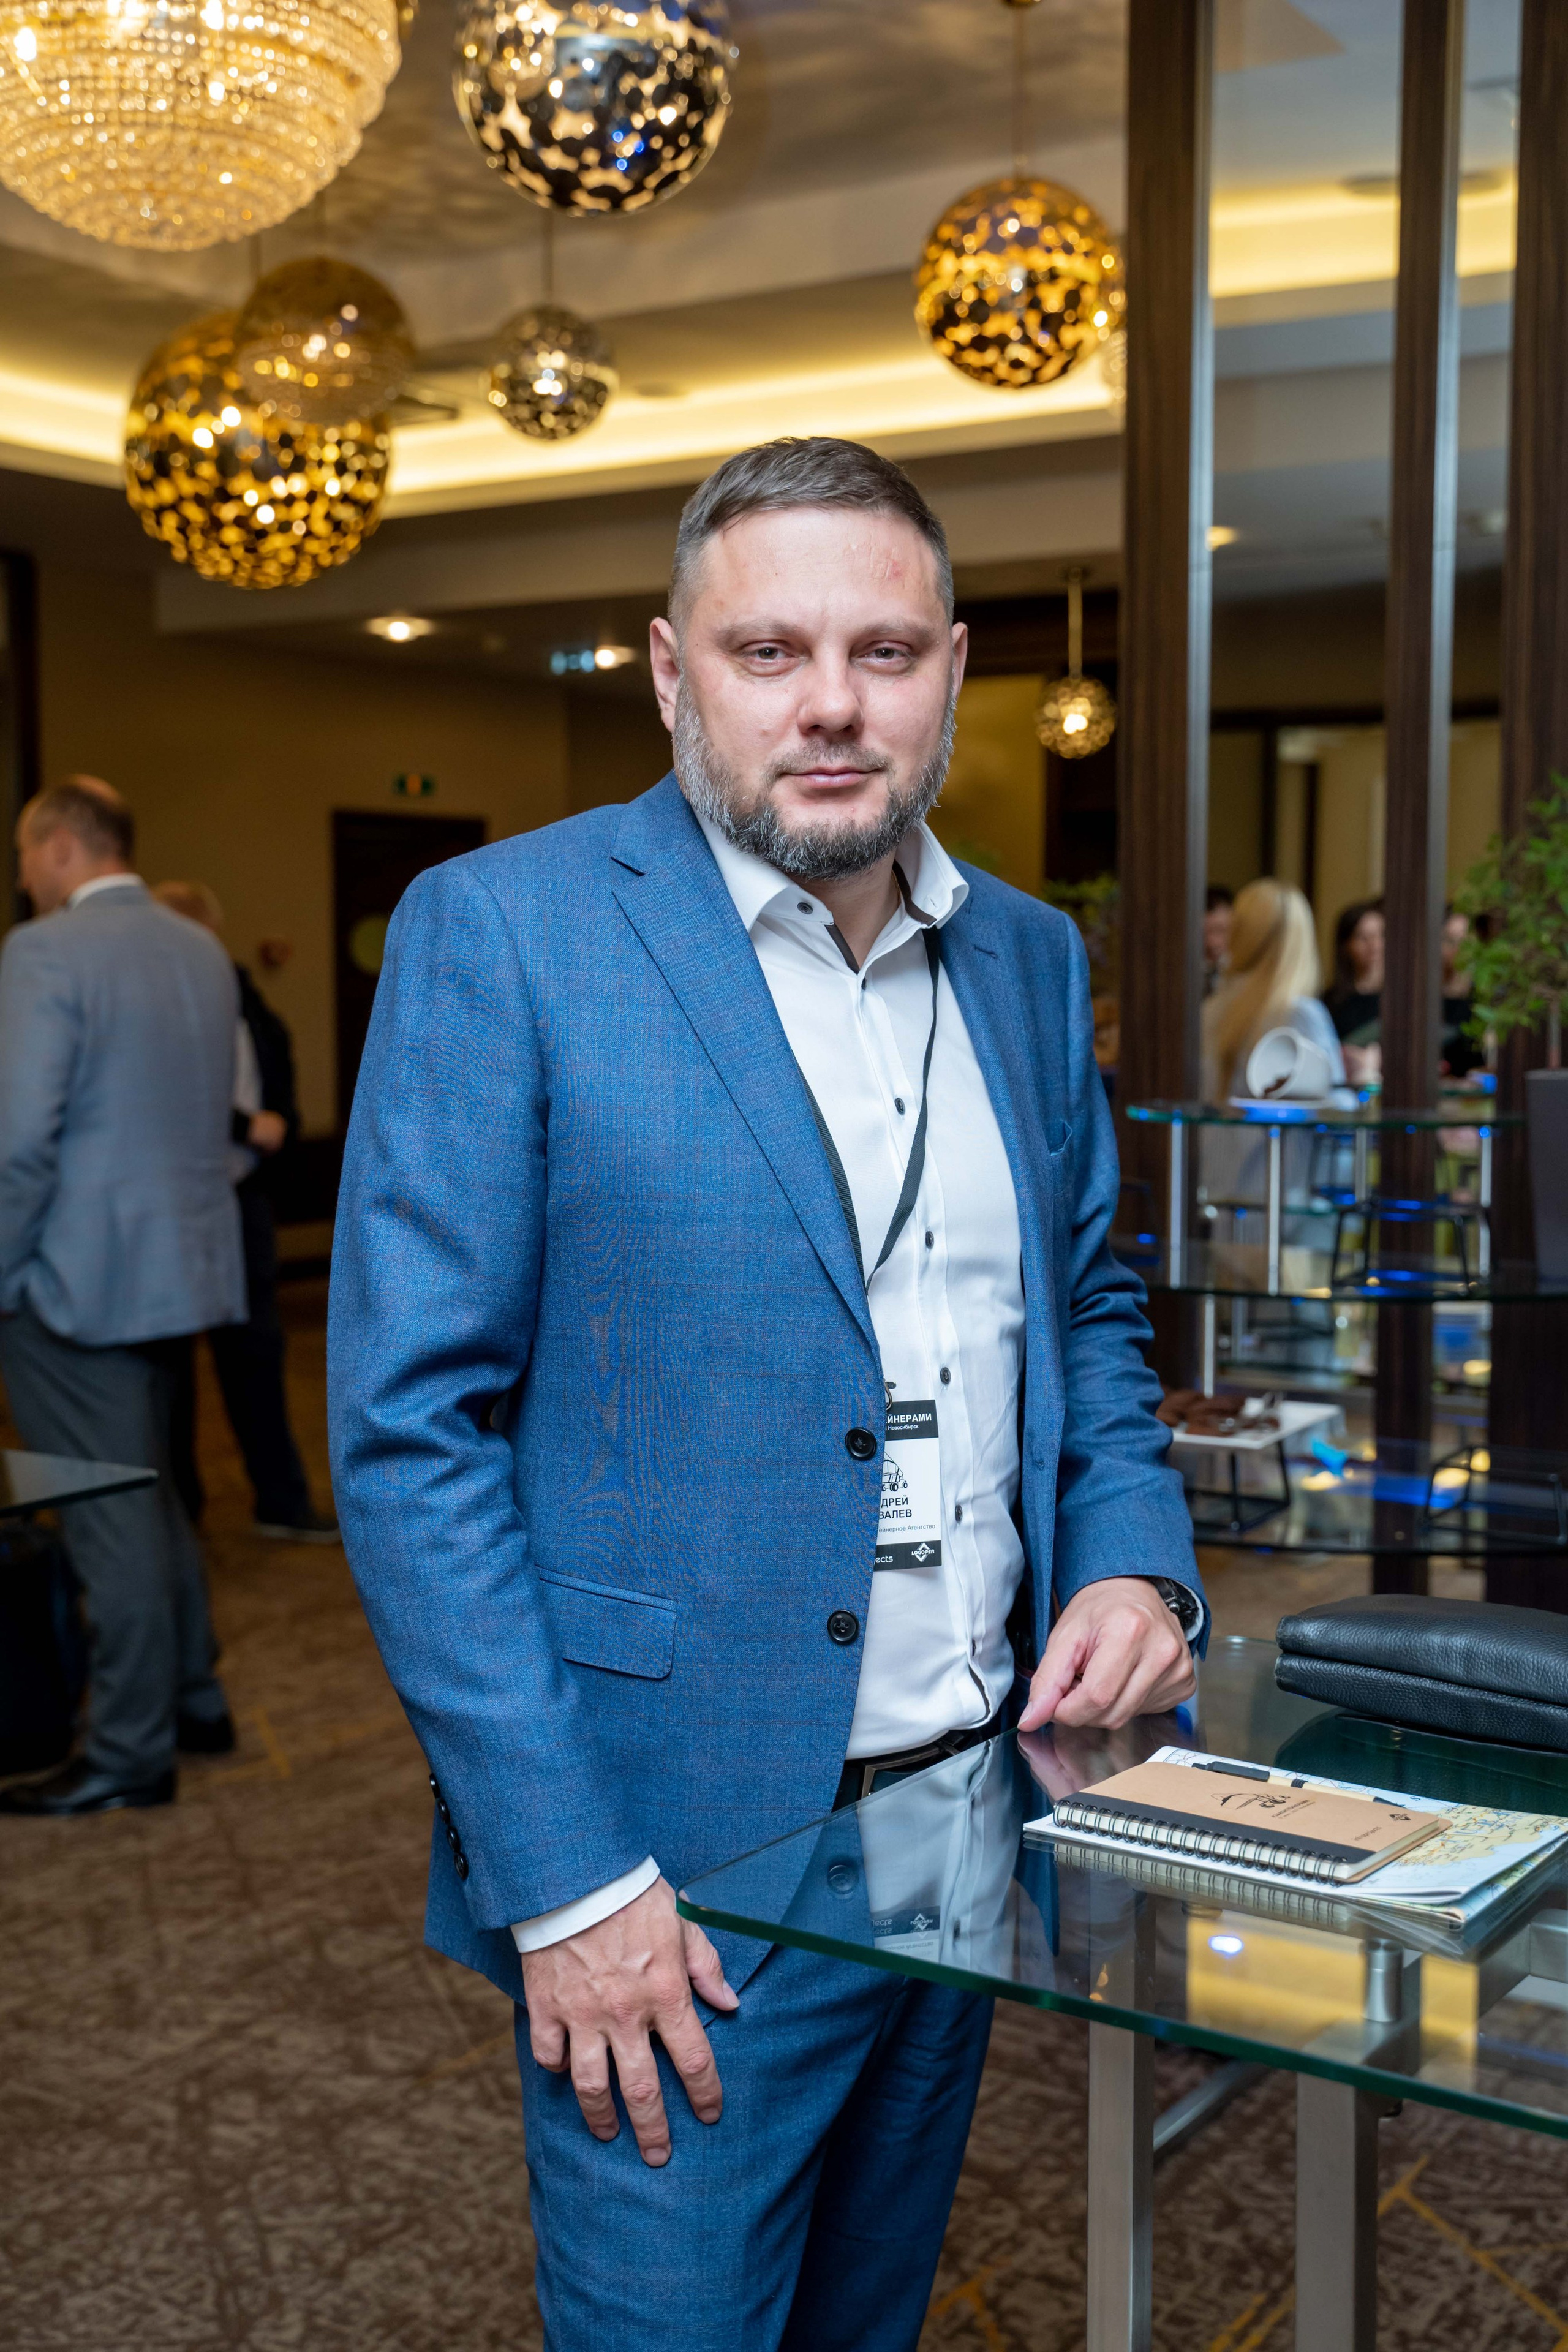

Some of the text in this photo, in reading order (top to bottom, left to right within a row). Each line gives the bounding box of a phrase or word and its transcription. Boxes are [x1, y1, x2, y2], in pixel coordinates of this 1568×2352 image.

[886, 1413, 932, 1423] ЙНЕРАМИ
[881, 1495, 908, 1508] ДРЕЙ
[873, 1555, 893, 1564] ects
